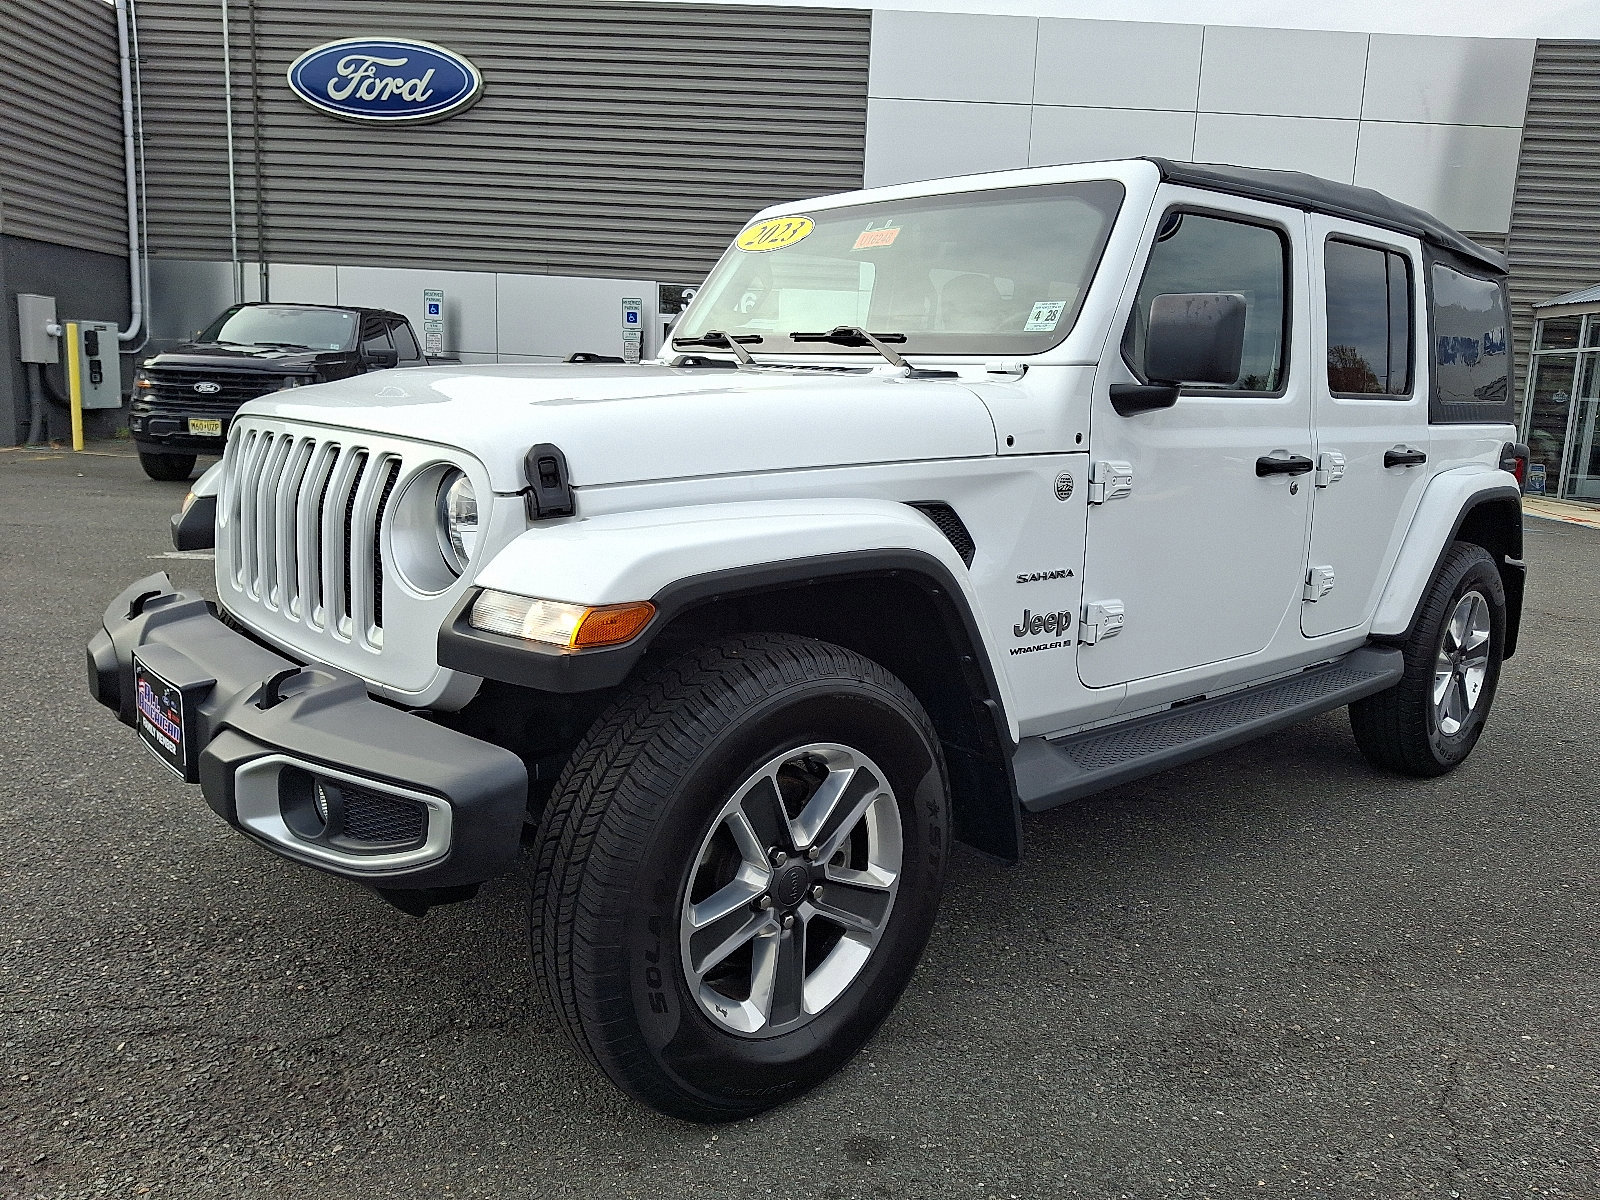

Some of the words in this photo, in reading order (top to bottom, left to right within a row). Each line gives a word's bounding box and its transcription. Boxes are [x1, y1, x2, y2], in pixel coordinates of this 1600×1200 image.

[326, 54, 436, 102] Ford
[745, 221, 806, 246] 2023
[1044, 309, 1058, 321] 28
[1015, 568, 1075, 584] SAHARA
[1013, 608, 1072, 638] Jeep
[1009, 641, 1062, 656] WRANGLER
